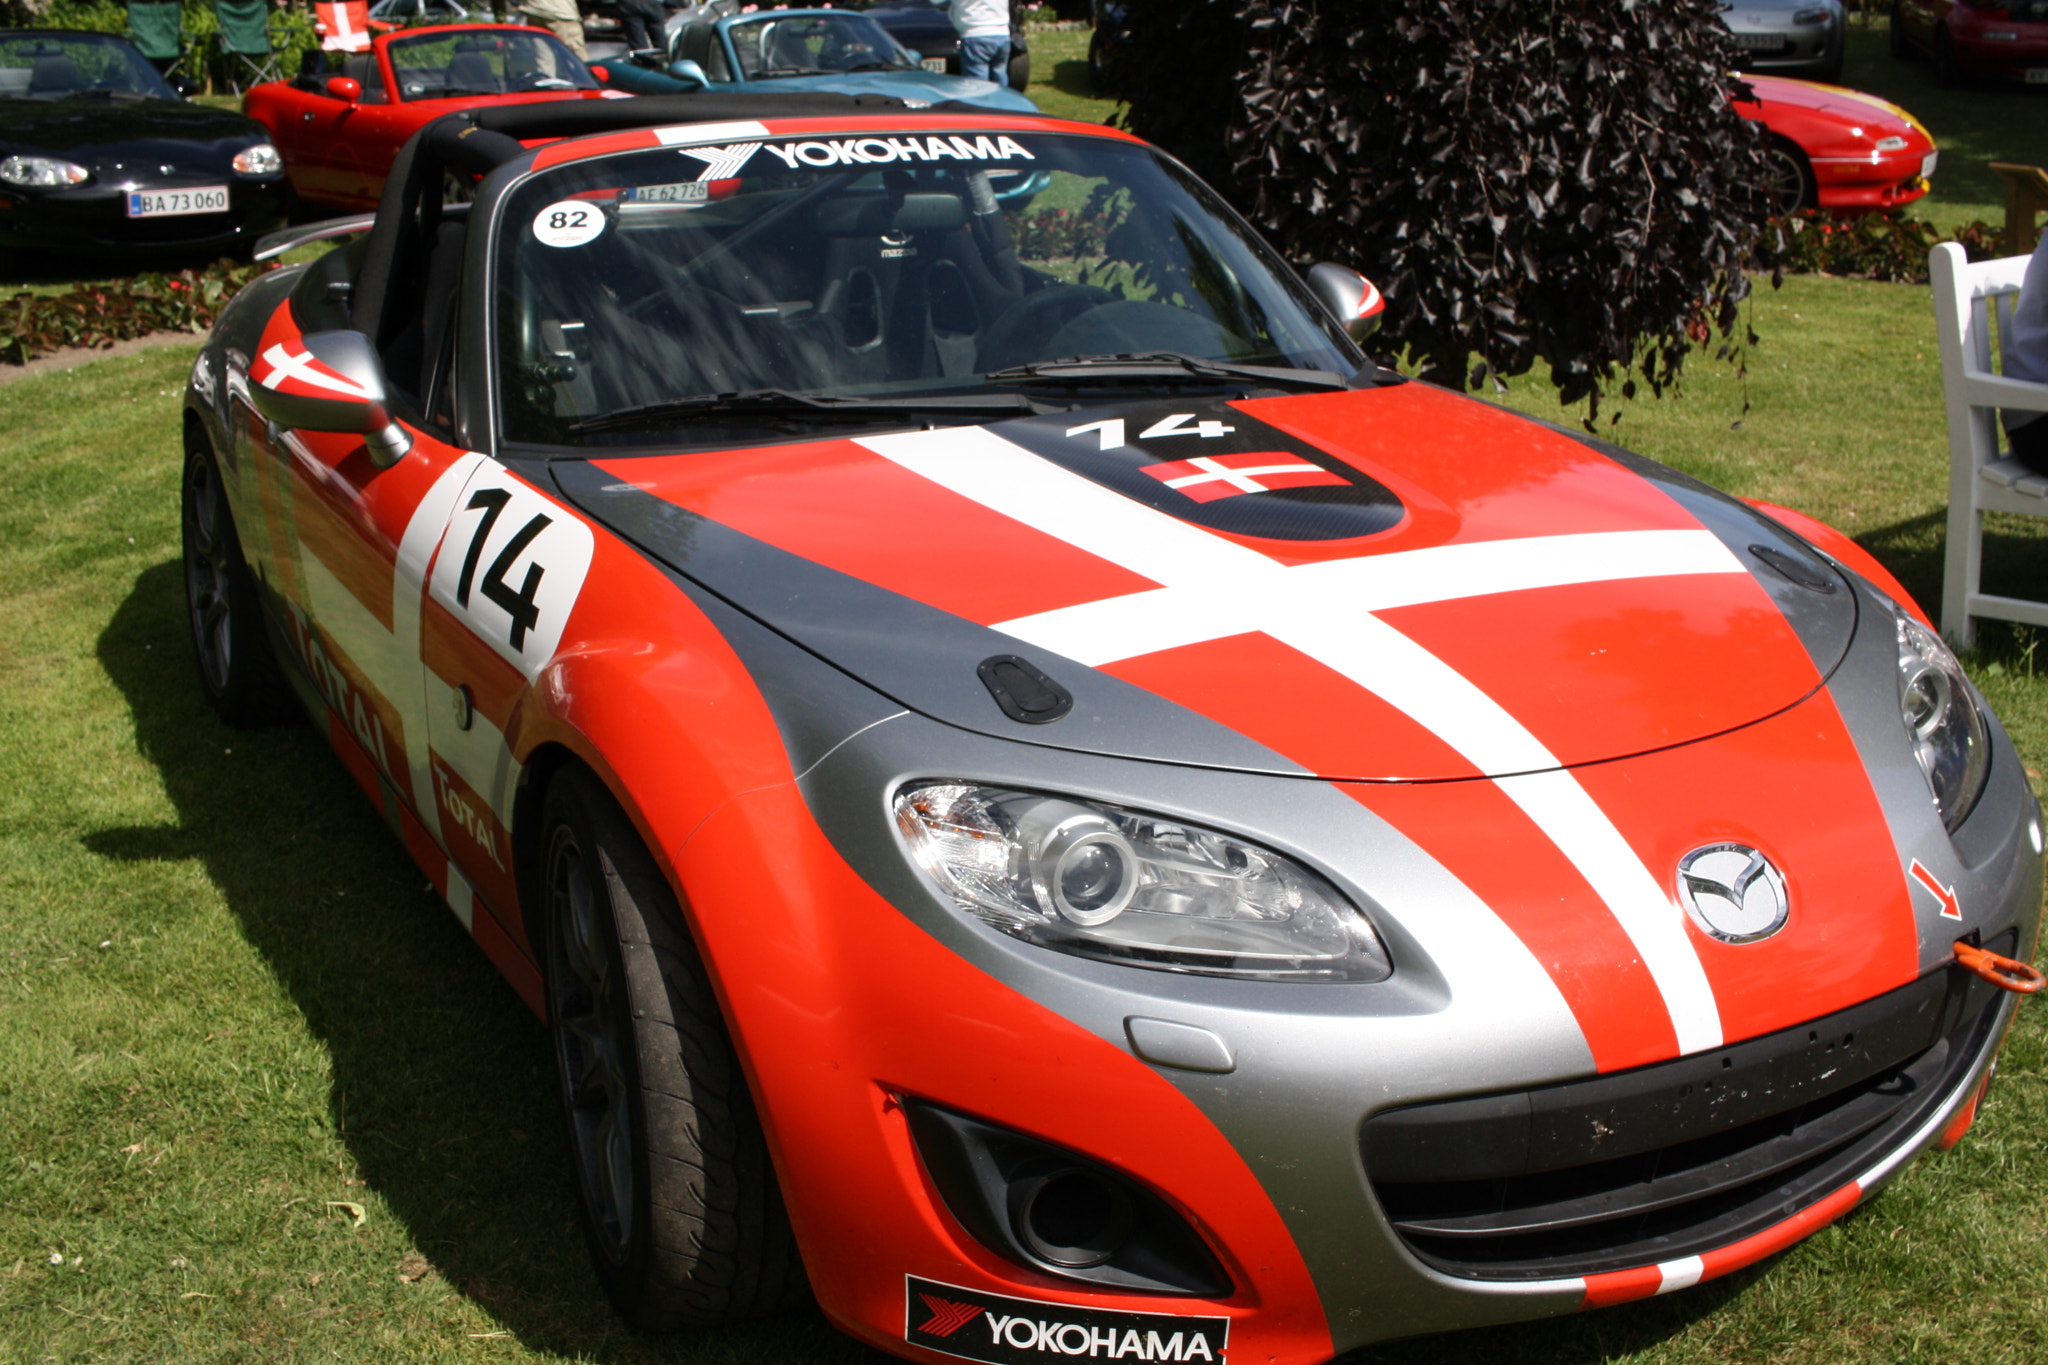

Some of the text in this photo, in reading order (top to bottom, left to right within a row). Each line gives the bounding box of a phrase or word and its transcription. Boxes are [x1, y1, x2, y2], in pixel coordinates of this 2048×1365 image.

[764, 136, 1035, 168] YOKOHAMA
[142, 196, 166, 212] BA
[170, 194, 190, 210] 73
[194, 192, 225, 209] 060
[660, 186, 677, 200] 62
[681, 183, 705, 198] 726
[549, 211, 588, 229] 82
[1066, 413, 1235, 450] 14
[457, 488, 554, 654] 14
[285, 592, 410, 808] TOTAL
[434, 762, 506, 873] TOTAL
[985, 1311, 1213, 1361] YOKOHAMA
